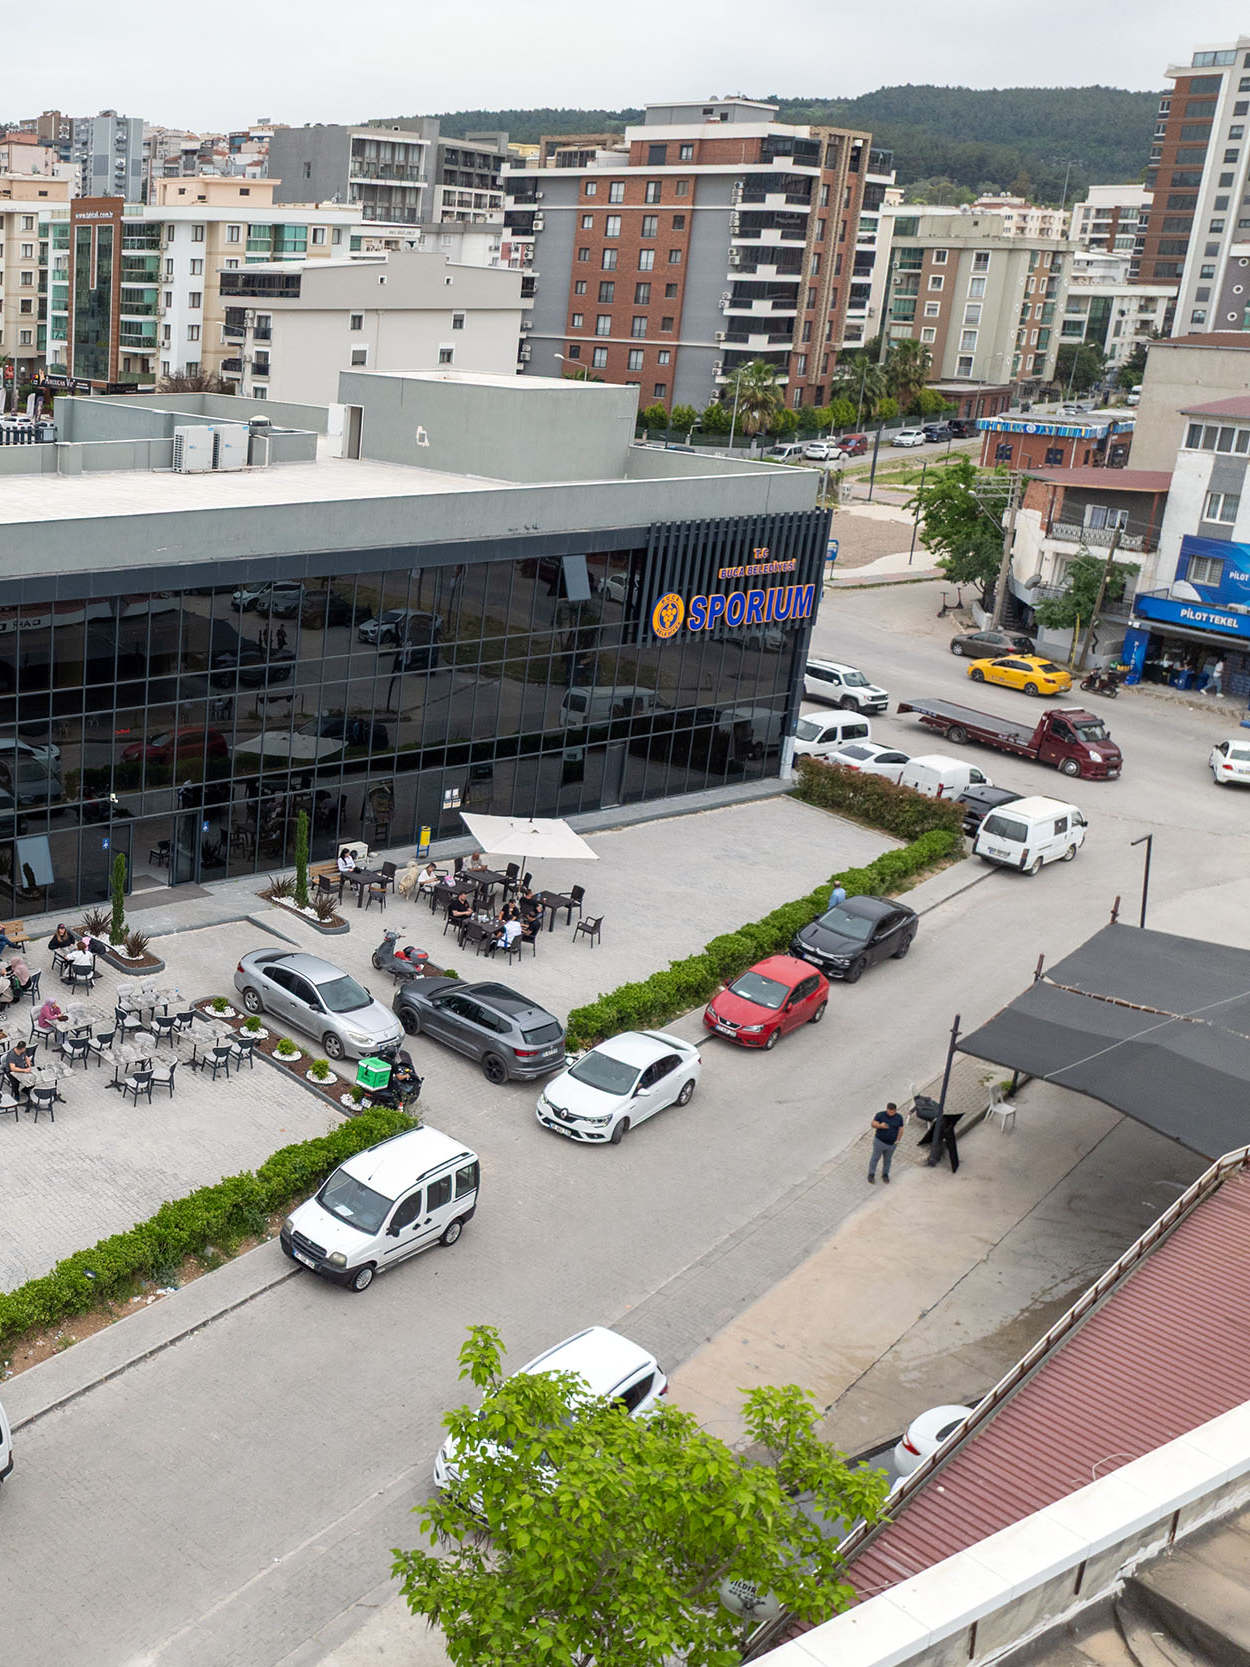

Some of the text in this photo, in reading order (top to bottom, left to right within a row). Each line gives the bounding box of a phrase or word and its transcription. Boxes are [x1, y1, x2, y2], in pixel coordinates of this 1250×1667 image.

[718, 558, 797, 579] BUCA BELEDİYESİ
[1229, 570, 1249, 581] PİLOT
[687, 583, 815, 631] SPORIUM
[1180, 608, 1239, 628] PİLOT TEKEL
